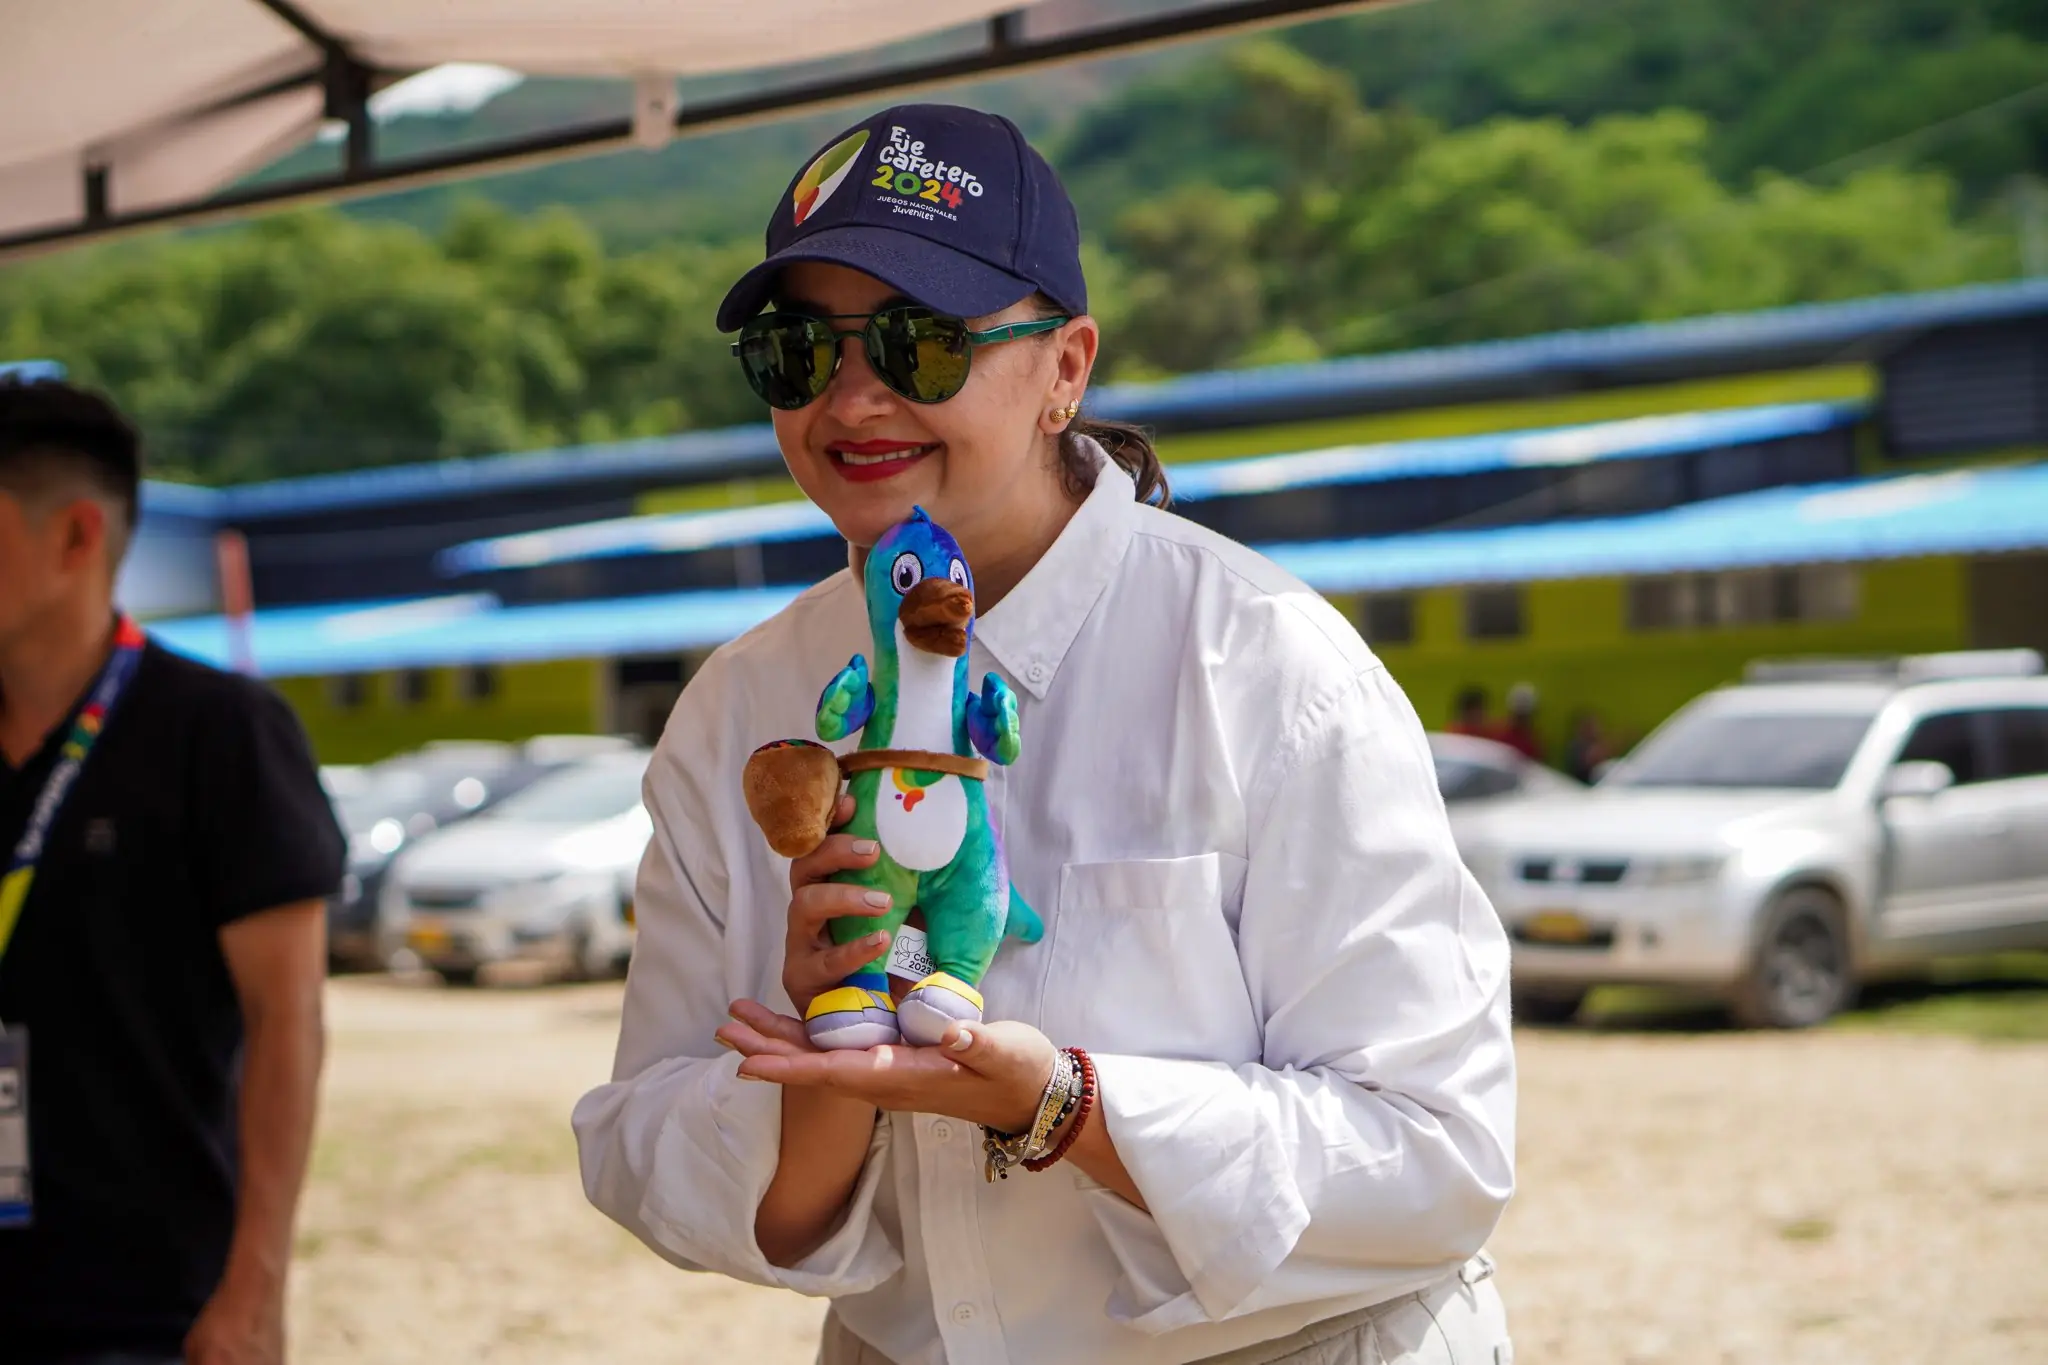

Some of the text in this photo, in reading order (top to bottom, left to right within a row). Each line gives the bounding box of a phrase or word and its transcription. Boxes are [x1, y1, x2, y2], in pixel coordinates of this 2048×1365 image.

[890, 125, 925, 156] Eje
[871, 165, 964, 209] 2024
[877, 195, 957, 221] JUEGOS NACIONALES
[892, 205, 934, 221] Juveniles
[908, 960, 932, 975] 2023
